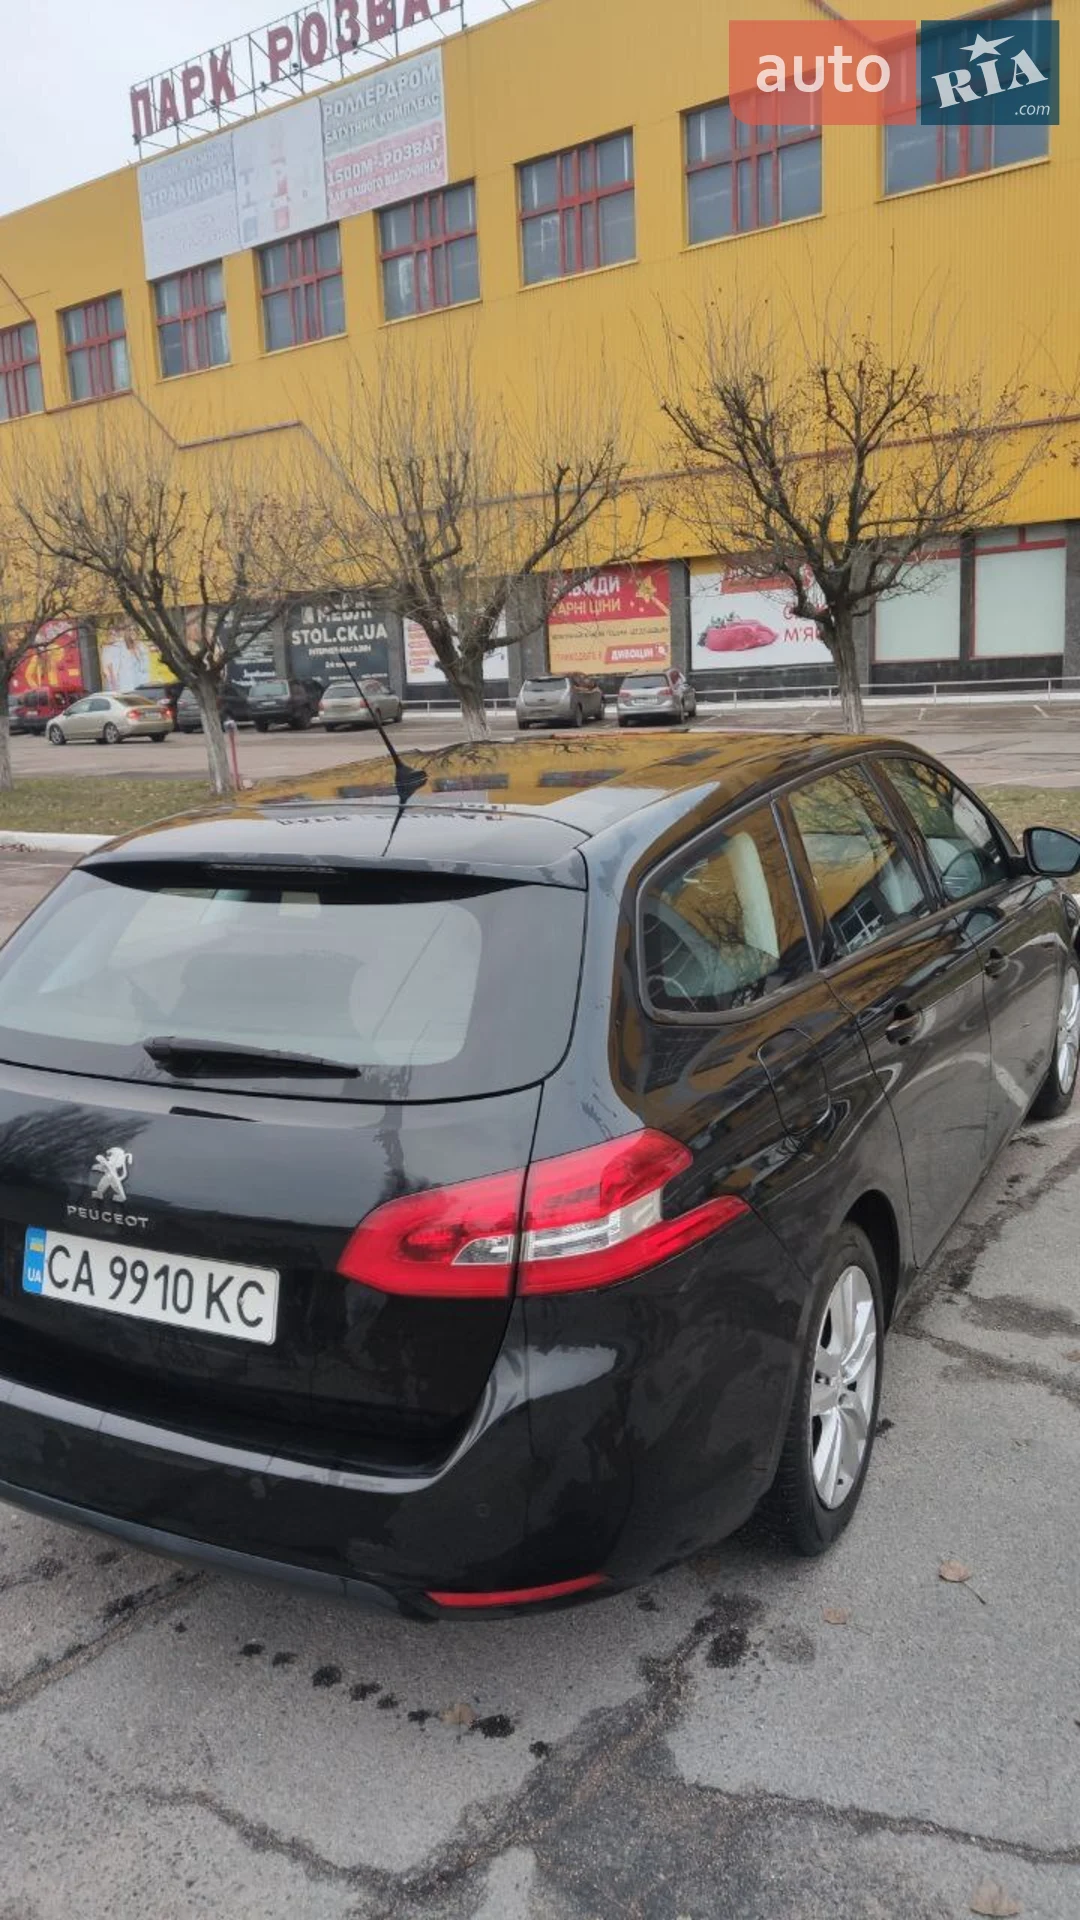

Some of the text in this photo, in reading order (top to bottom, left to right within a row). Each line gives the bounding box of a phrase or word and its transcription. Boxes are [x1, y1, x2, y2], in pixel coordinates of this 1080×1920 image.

[130, 0, 456, 138] ПАРК РОЗВА
[323, 63, 437, 122] РОЛЛЕРДРОМ
[380, 93, 440, 126] КОМПЛЕКС
[383, 134, 440, 168] РОЗВАГ
[551, 576, 620, 598] ЗВЖДИ
[589, 598, 621, 616] ЦІНИ
[292, 623, 388, 645] STOL.CK.UA
[67, 1205, 149, 1229] PEUGEOT
[27, 1268, 41, 1284] UA
[48, 1245, 265, 1328] CA 9910 KC
